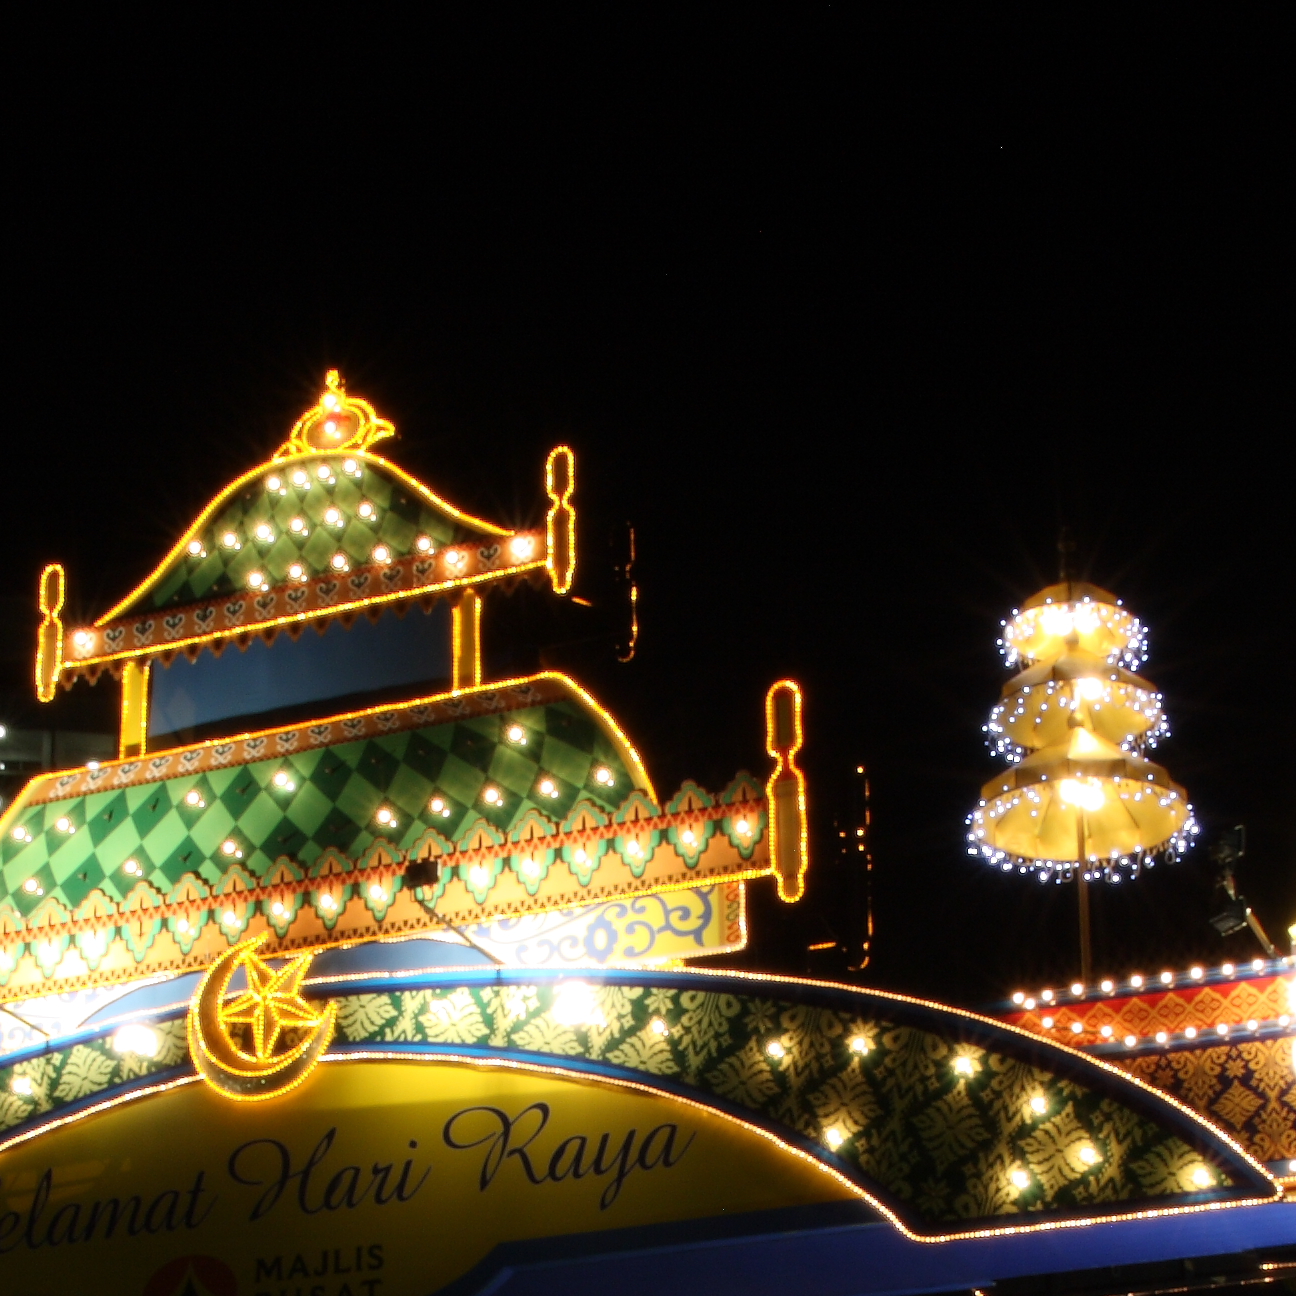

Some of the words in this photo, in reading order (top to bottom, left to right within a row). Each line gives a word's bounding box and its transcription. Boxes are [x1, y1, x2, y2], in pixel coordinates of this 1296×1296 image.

[228, 1126, 433, 1223] Hari
[442, 1102, 696, 1212] Raya
[254, 1244, 385, 1285] MAJLIS
